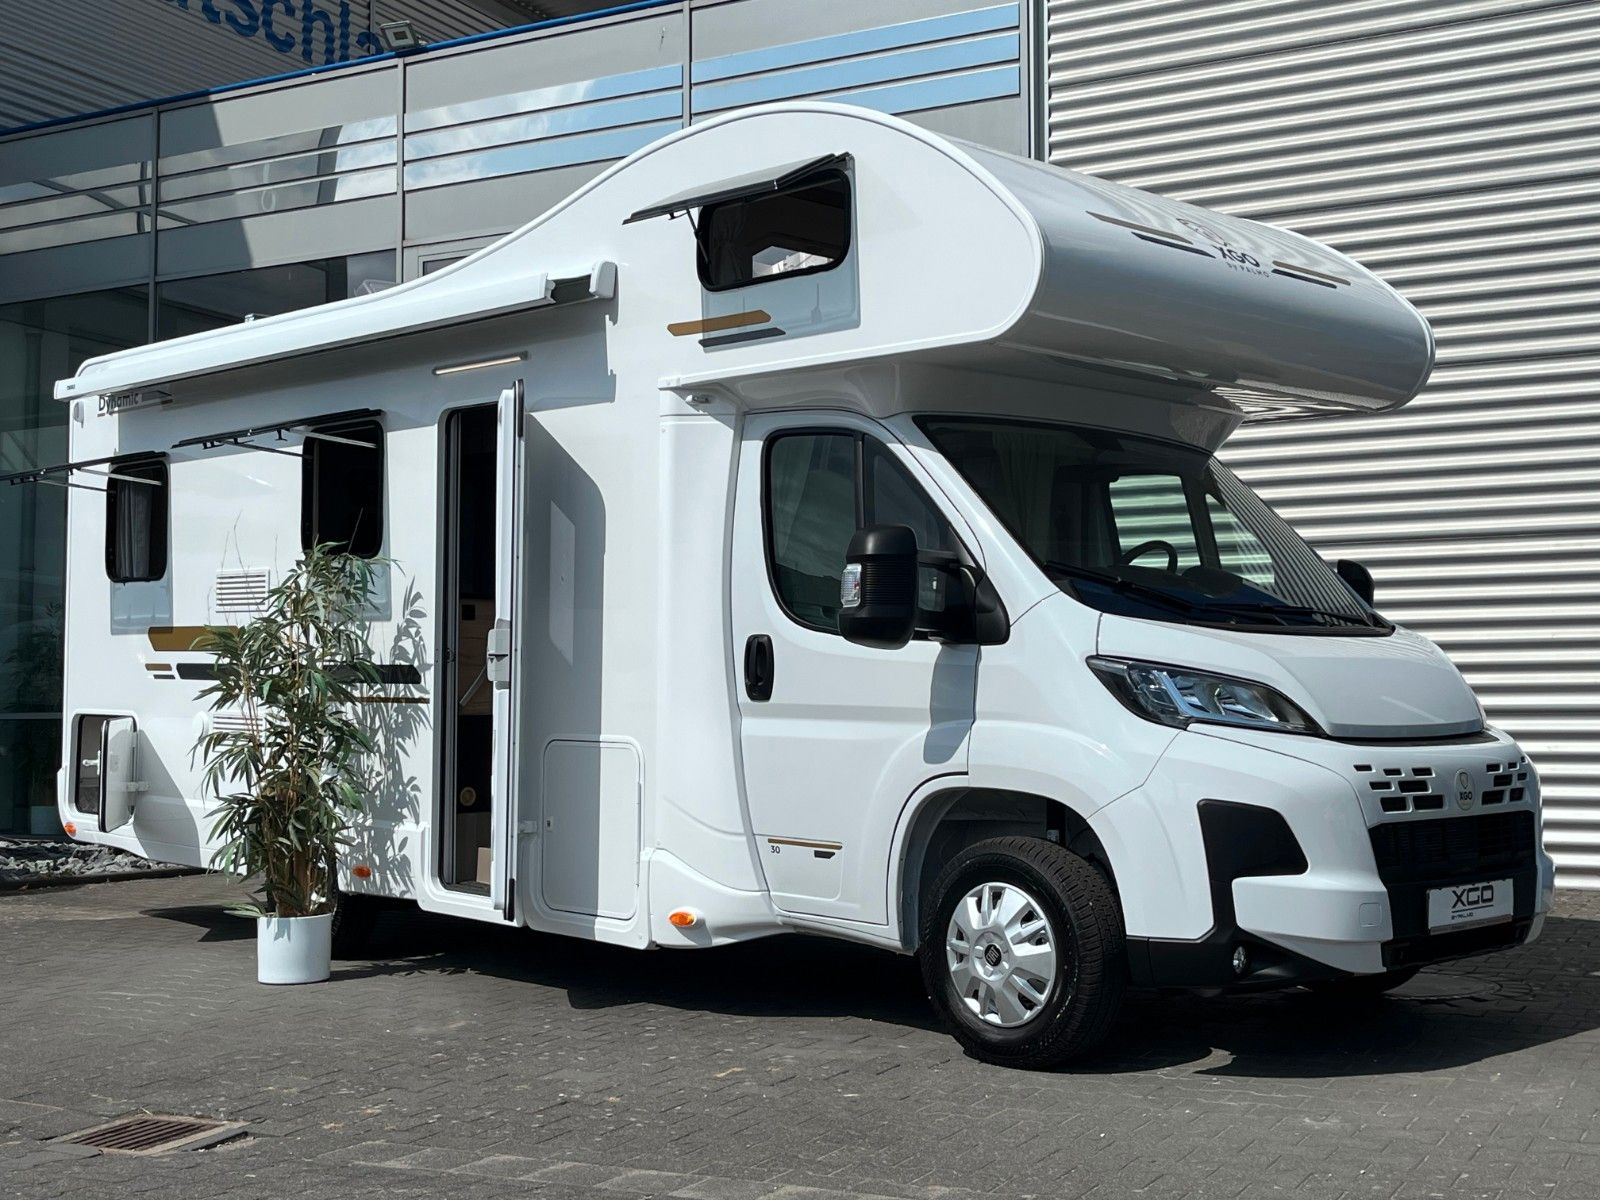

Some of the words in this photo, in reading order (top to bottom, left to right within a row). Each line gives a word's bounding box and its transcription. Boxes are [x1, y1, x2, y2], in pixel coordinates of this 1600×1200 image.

[1211, 244, 1261, 268] XGO
[98, 392, 140, 415] Dynamic
[1459, 791, 1473, 801] XGO
[770, 845, 781, 854] 30
[1451, 885, 1494, 909] XGO
